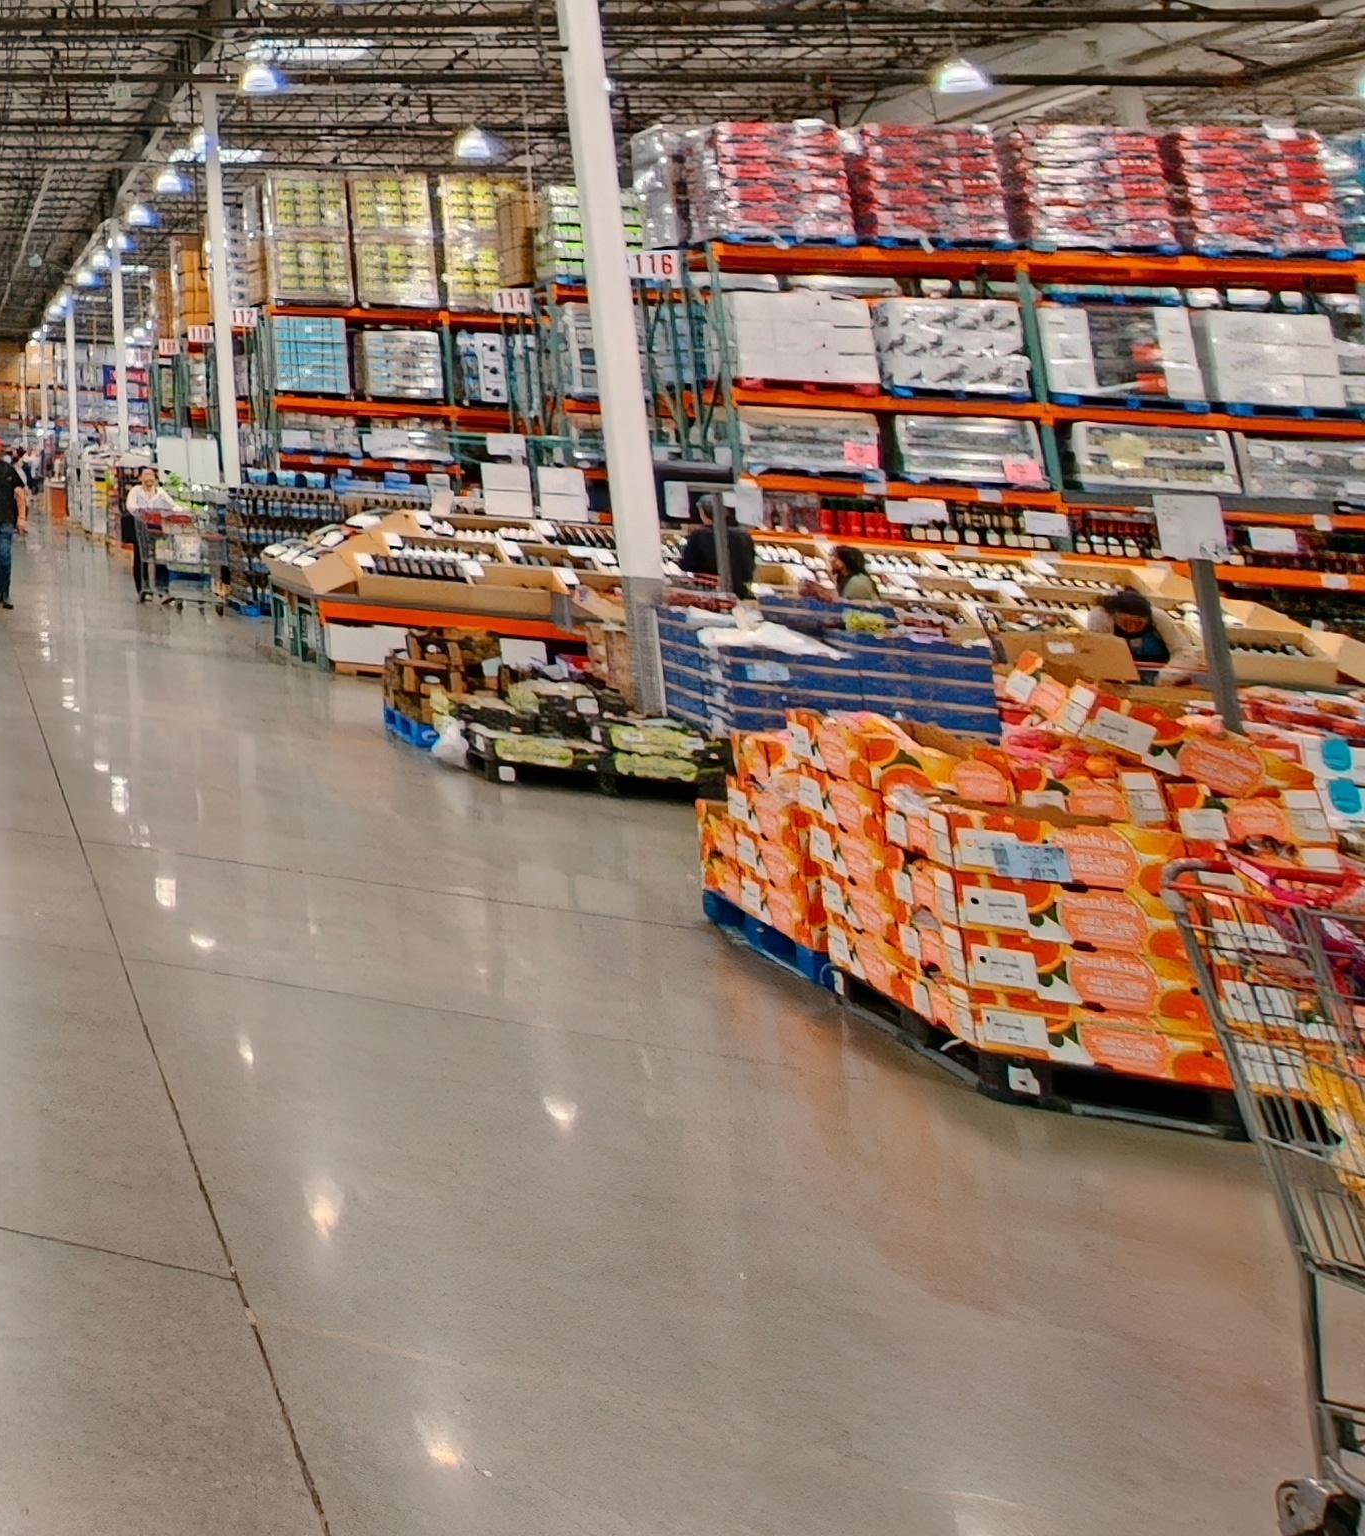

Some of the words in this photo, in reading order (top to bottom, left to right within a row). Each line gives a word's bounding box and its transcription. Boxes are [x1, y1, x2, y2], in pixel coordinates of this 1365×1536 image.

[634, 252, 674, 276] 116
[497, 292, 527, 308] 114
[232, 309, 254, 324] 112
